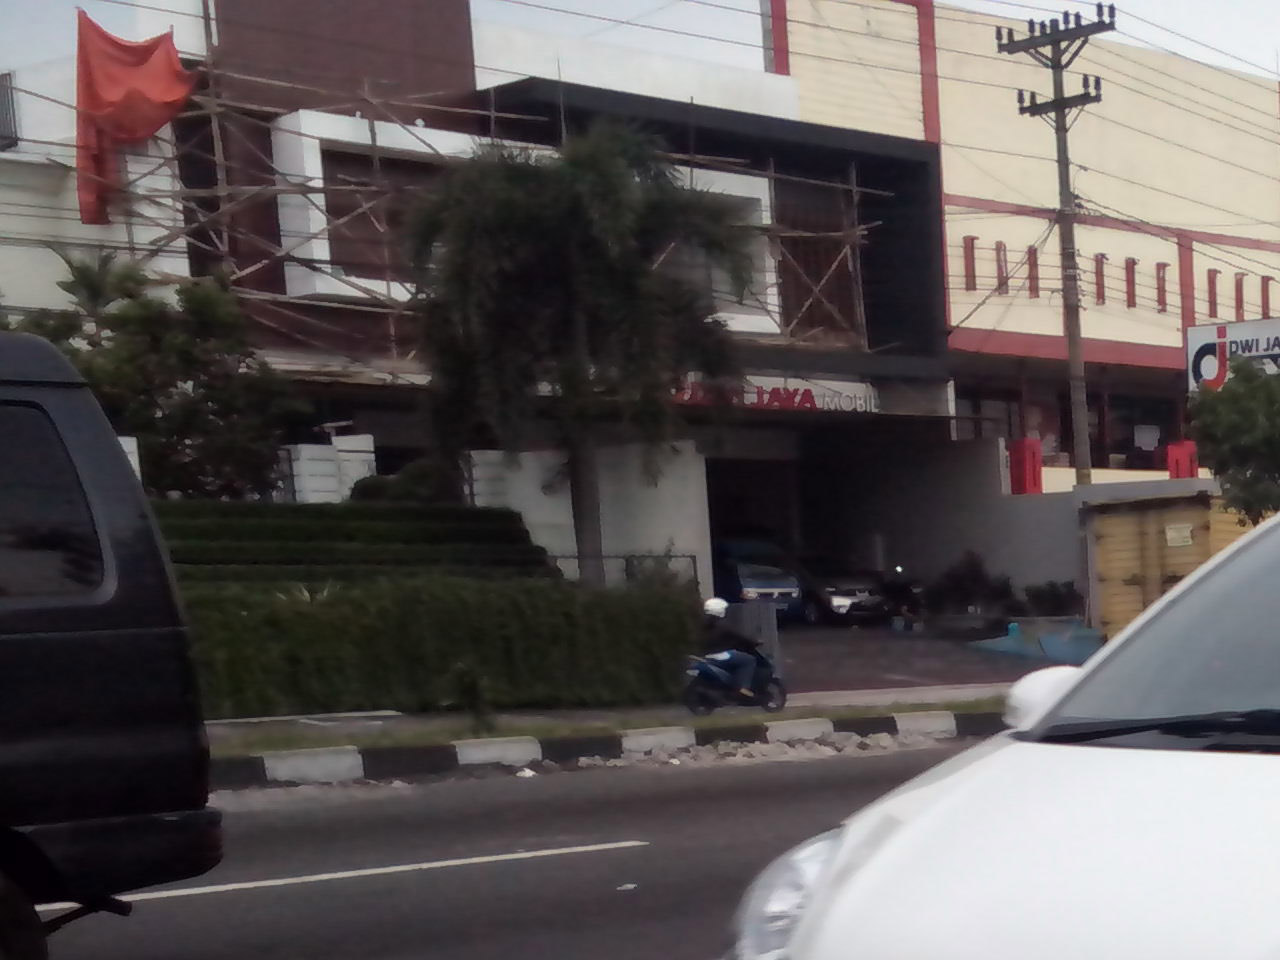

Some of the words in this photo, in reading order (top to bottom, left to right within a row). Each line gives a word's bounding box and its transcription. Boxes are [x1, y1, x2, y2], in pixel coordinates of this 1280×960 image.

[1229, 338, 1259, 354] DWI
[754, 385, 817, 410] JAYA
[823, 383, 880, 413] MOBIL
